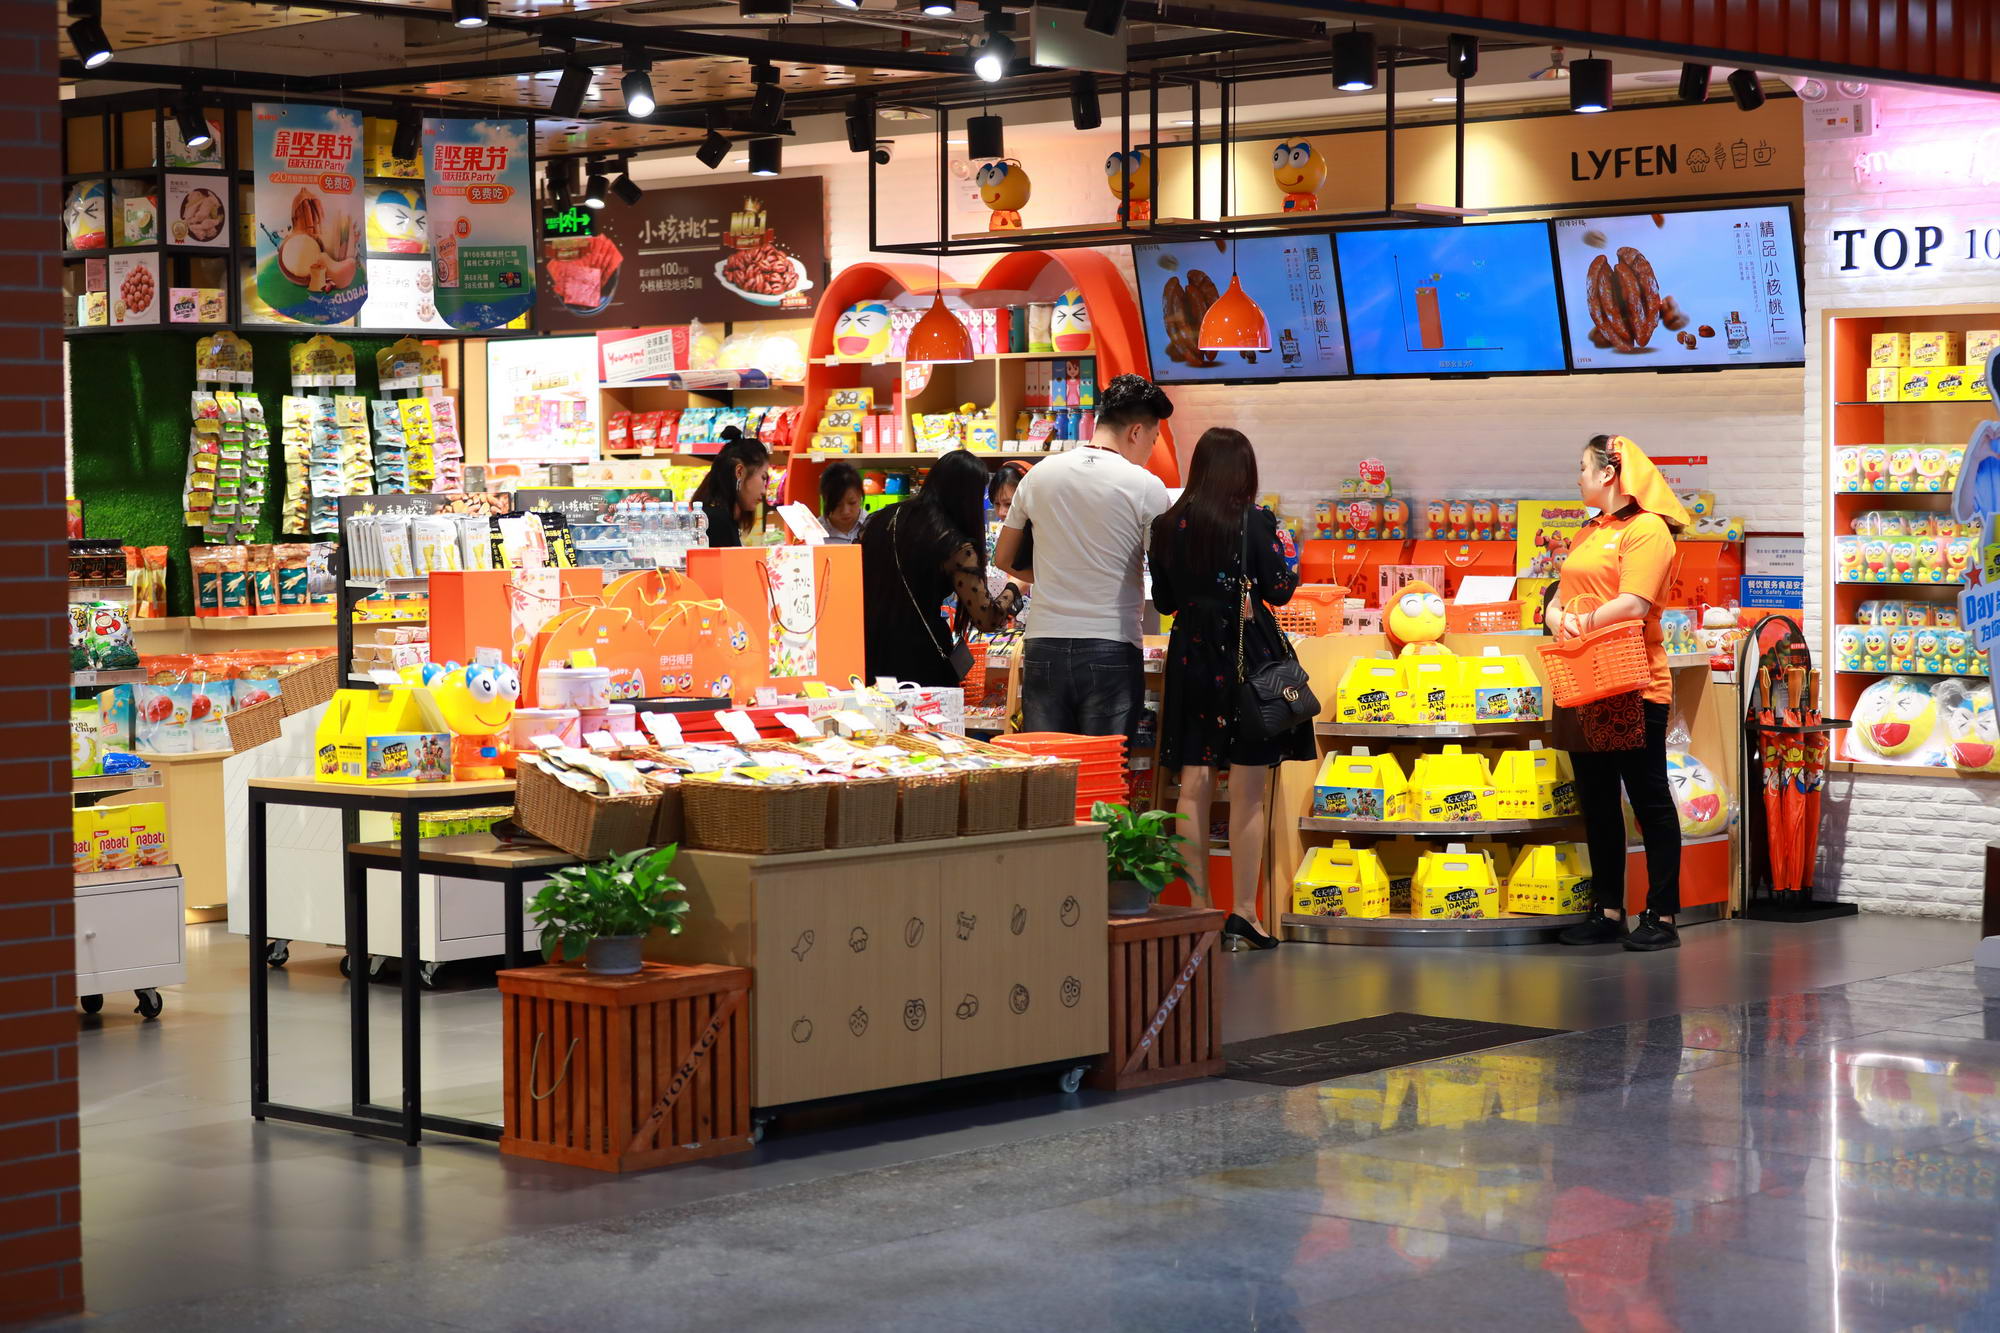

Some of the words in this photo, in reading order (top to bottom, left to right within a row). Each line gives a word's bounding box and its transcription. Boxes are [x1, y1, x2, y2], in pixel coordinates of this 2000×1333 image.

[289, 132, 353, 160] 坚果节
[443, 145, 508, 171] 坚果节
[1571, 143, 1677, 181] LYFEN
[324, 160, 345, 171] Party
[325, 176, 350, 190] 免费吃
[471, 172, 496, 182] Party
[472, 188, 504, 200] 免费吃
[638, 214, 721, 245] 小核桃仁
[731, 211, 767, 236] NO.1
[1833, 226, 1944, 271] TOP
[1760, 220, 1787, 335] 精品小核桃仁
[334, 286, 368, 304] GLOBAL
[1305, 247, 1333, 350] 精品小核桃仁
[1766, 588, 1782, 596] Safety
[1966, 592, 1994, 625] Day
[1361, 701, 1382, 711] DAILY
[1373, 703, 1390, 714] NUTS
[75, 725, 98, 733] Chips
[1447, 800, 1469, 811] DAILY
[1460, 803, 1478, 814] NUTS
[100, 836, 129, 850] nabati
[136, 832, 165, 846] nabati
[1315, 896, 1335, 906] DAILY
[1448, 899, 1471, 910] DAILY
[1461, 902, 1480, 912] NUTS
[1141, 952, 1202, 1050] STORAGE
[651, 1015, 723, 1119] STORAGE
